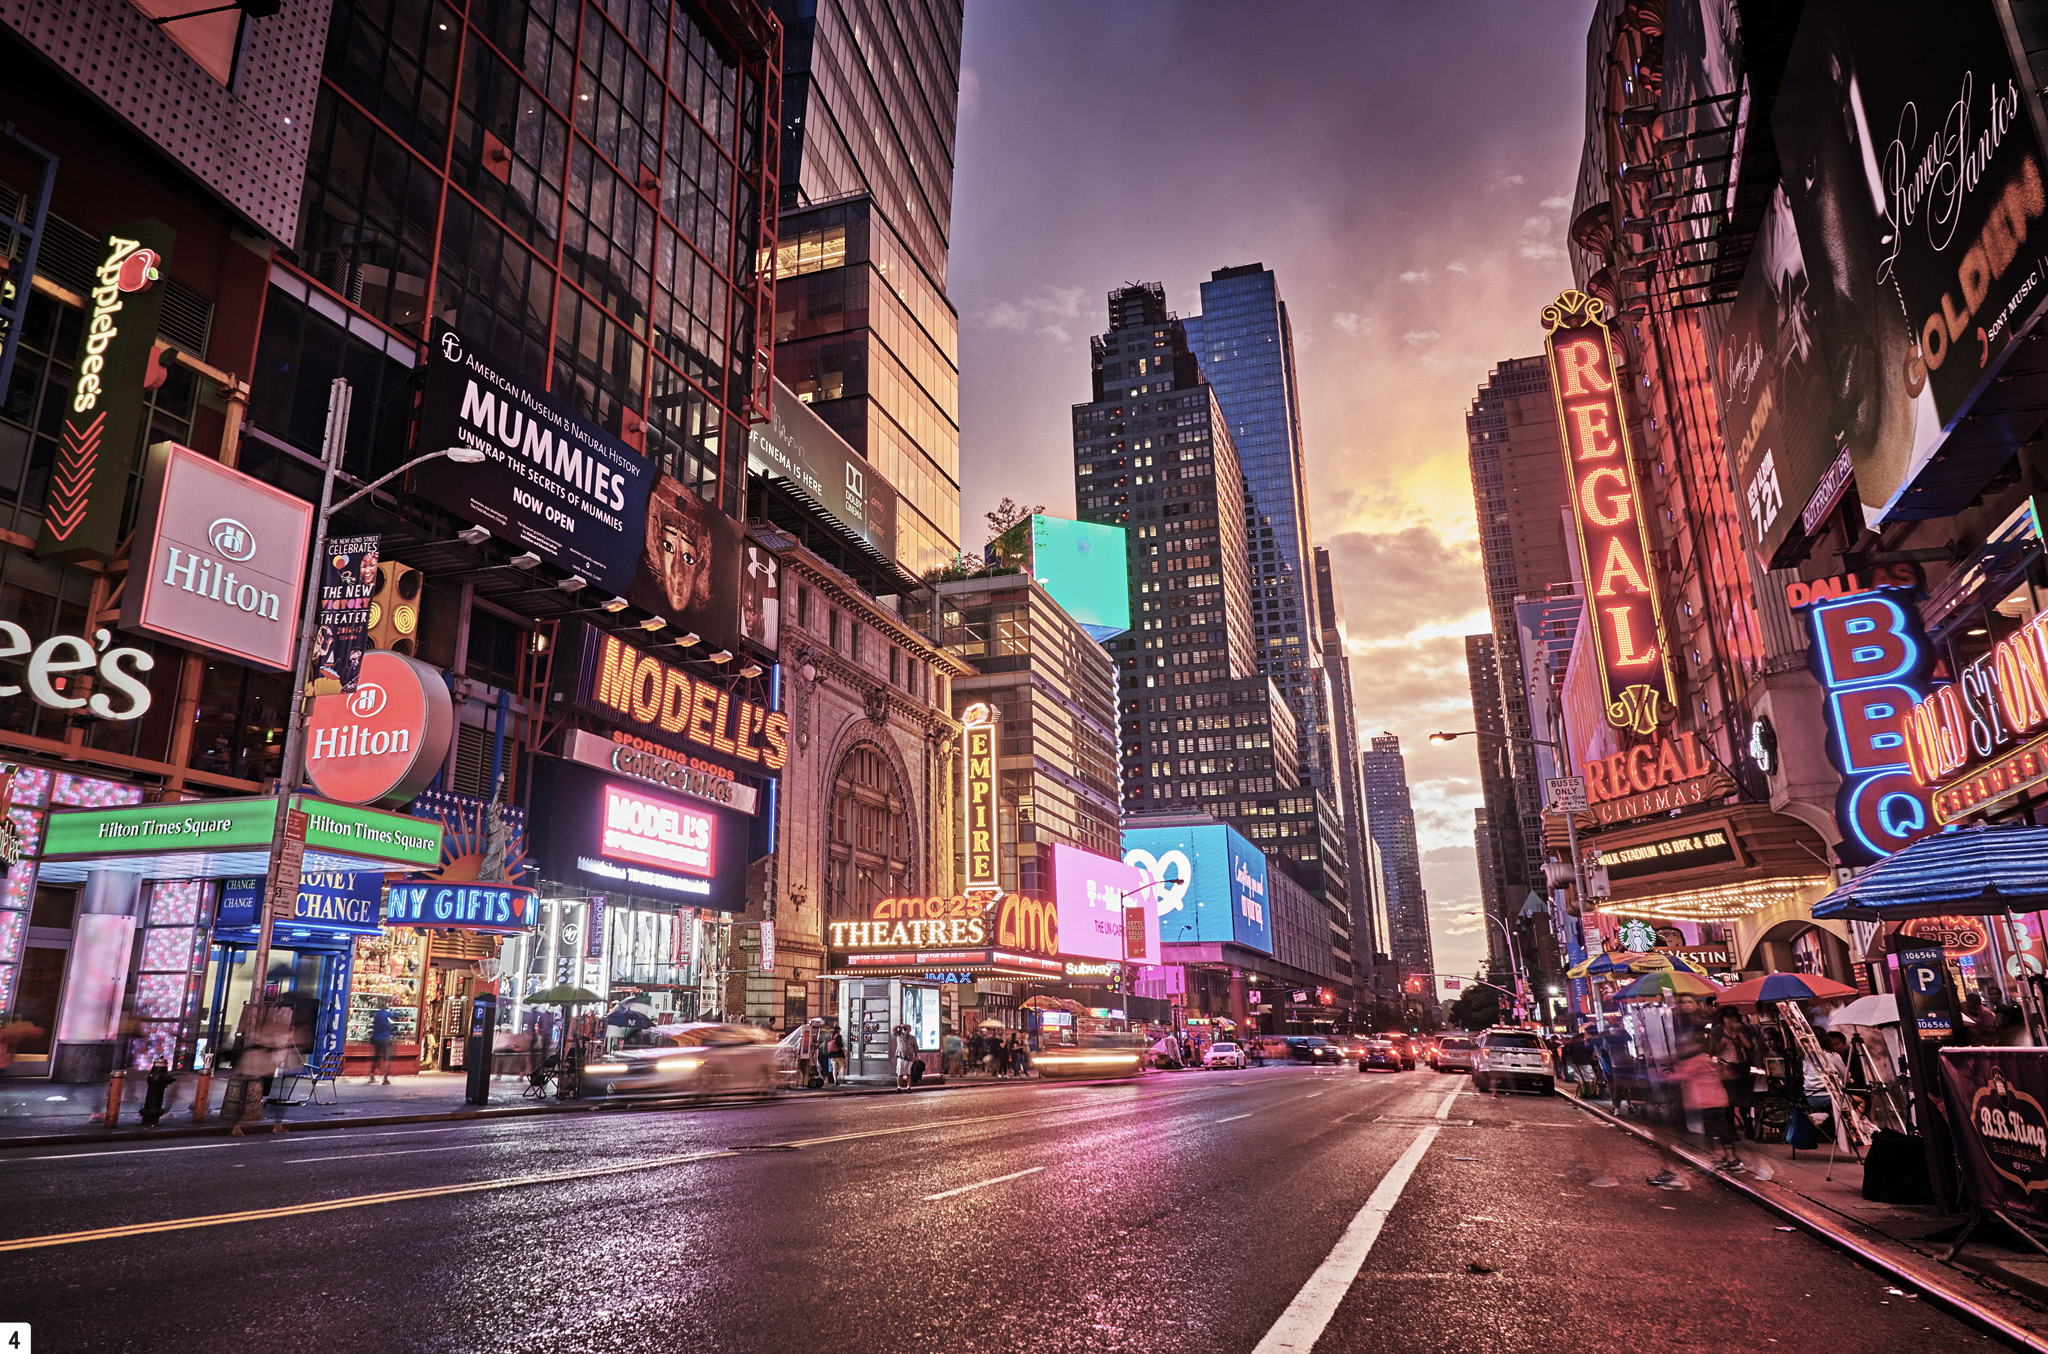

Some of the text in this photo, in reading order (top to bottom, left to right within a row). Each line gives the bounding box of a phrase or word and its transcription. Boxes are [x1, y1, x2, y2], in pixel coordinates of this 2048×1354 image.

[1927, 71, 2018, 251] Santos
[74, 235, 141, 413] Applebee's
[1988, 272, 2038, 341] SONY MUSIC
[465, 353, 520, 399] AMERICAN
[521, 389, 563, 424] MUSEUM
[571, 422, 607, 457] NATURAL
[608, 447, 641, 478] HISTORY
[459, 379, 626, 512] MUMMIES
[458, 426, 624, 532] UNWRAP THE SECRETS OF MUMMIES
[760, 437, 791, 470] CINEMA
[793, 464, 801, 478] IS
[803, 469, 822, 497] HERE
[512, 487, 544, 516] NOW
[545, 505, 575, 533] OPEN
[1555, 340, 1656, 668] REGAL
[1751, 467, 1783, 544] 7.21
[328, 542, 378, 556] CELEBRATES
[163, 546, 281, 622] Hilton
[323, 584, 373, 599] THE NEW
[320, 612, 367, 625] THEATER
[321, 597, 372, 610] VICTORY
[598, 635, 790, 770] MODELL'S
[312, 723, 409, 760] Hilton
[1813, 597, 1959, 857] BBQ
[1903, 684, 1968, 788] COLD
[613, 730, 735, 780] SPORTING GOODS
[1582, 730, 1711, 806] REGAL
[1551, 779, 1579, 787] BUSES
[969, 733, 992, 877] EMPIRE
[1601, 783, 1702, 822] CINEMAS
[99, 817, 232, 838] Hilton Times Square
[308, 814, 351, 837] Hilton
[353, 822, 392, 844] Times
[393, 830, 435, 851] Square
[608, 795, 709, 850] MODELL'S
[1619, 845, 1658, 863] STADIUM
[1658, 842, 1673, 856] 13
[1672, 838, 1694, 854] RPX
[1693, 836, 1704, 850] &
[1704, 832, 1726, 847] 4DX
[226, 879, 256, 890] CHANGE
[299, 872, 357, 891] ONEY
[223, 897, 254, 909] CHANGE
[294, 893, 371, 923] CHANGE
[388, 888, 428, 919] NY
[434, 889, 511, 922] GIFTS
[595, 897, 604, 945] MODELL'S
[950, 896, 983, 917] 25
[829, 918, 985, 948] THEATRES
[1065, 962, 1113, 976] Subway
[1905, 952, 1937, 960] 106566
[1917, 968, 1935, 991] P
[1918, 1021, 1950, 1029] 106566
